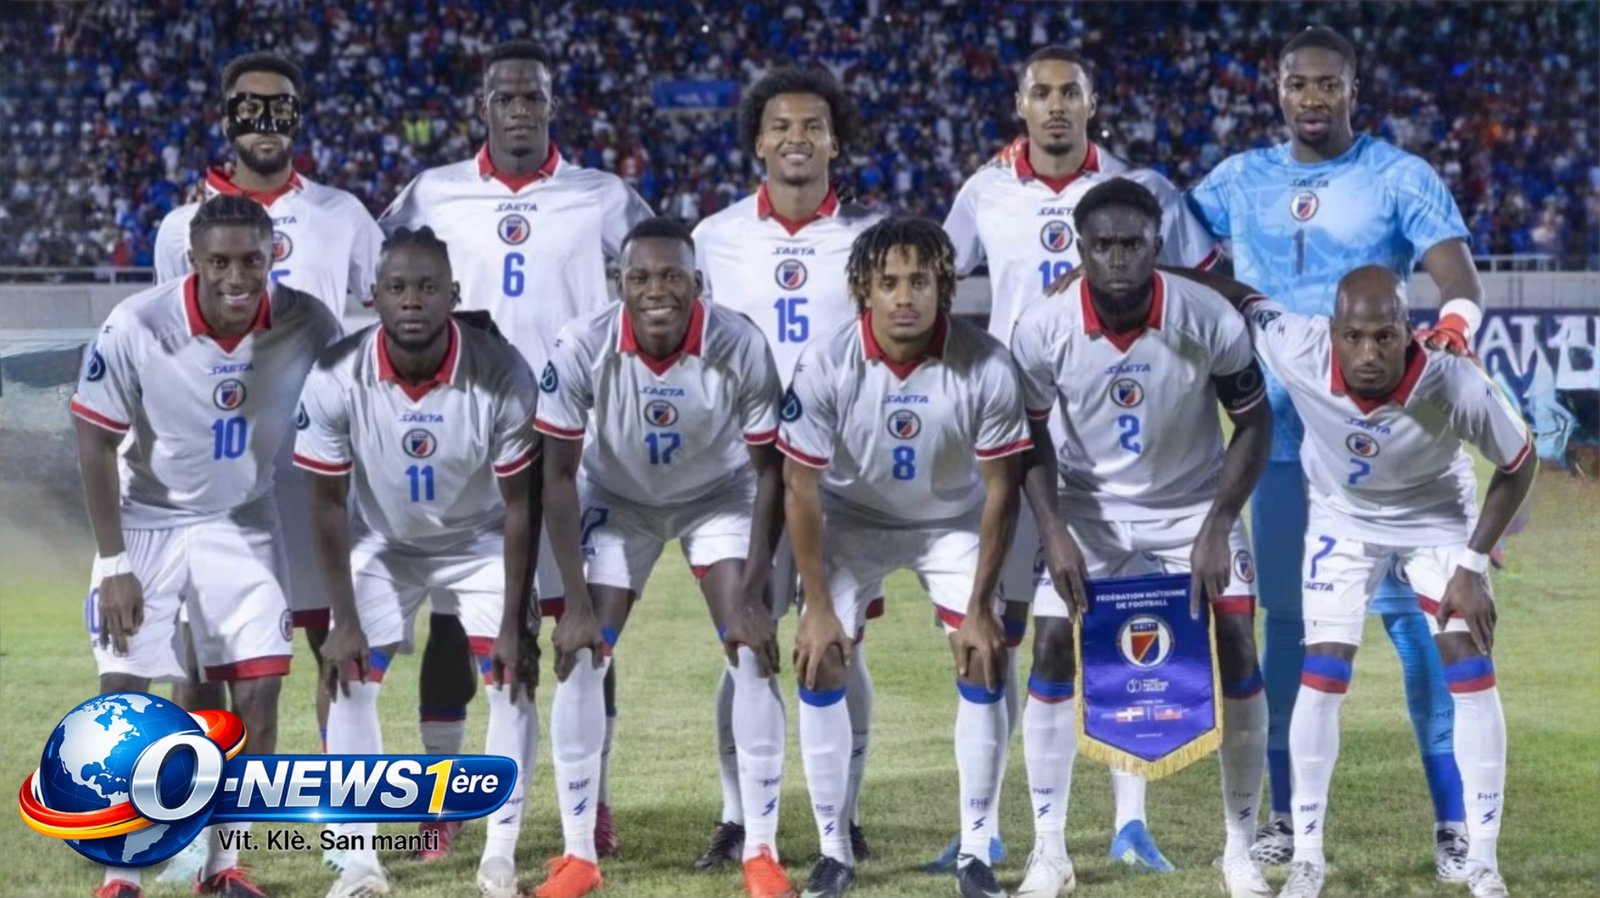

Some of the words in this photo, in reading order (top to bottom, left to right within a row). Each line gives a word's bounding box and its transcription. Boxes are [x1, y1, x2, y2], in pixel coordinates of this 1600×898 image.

[494, 203, 538, 212] SAETA
[1037, 207, 1074, 216] SAET
[272, 216, 297, 226] ETA
[772, 246, 816, 256] SAETA
[1292, 229, 1304, 275] 1
[503, 252, 525, 297] 6
[773, 298, 809, 343] 15
[208, 363, 254, 376] SAETA
[1105, 363, 1151, 374] SAETA
[639, 386, 685, 397] SAETA
[884, 394, 928, 404] SAETA
[399, 413, 444, 423] SAETA
[211, 416, 247, 461] 10
[1118, 414, 1141, 454] 2
[644, 432, 681, 465] 17
[892, 445, 915, 481] 8
[1348, 458, 1371, 485] 7
[405, 464, 434, 503] 11
[1310, 535, 1337, 579] 7
[1115, 602, 1127, 610] DE
[1128, 599, 1169, 608] FOOTBALL
